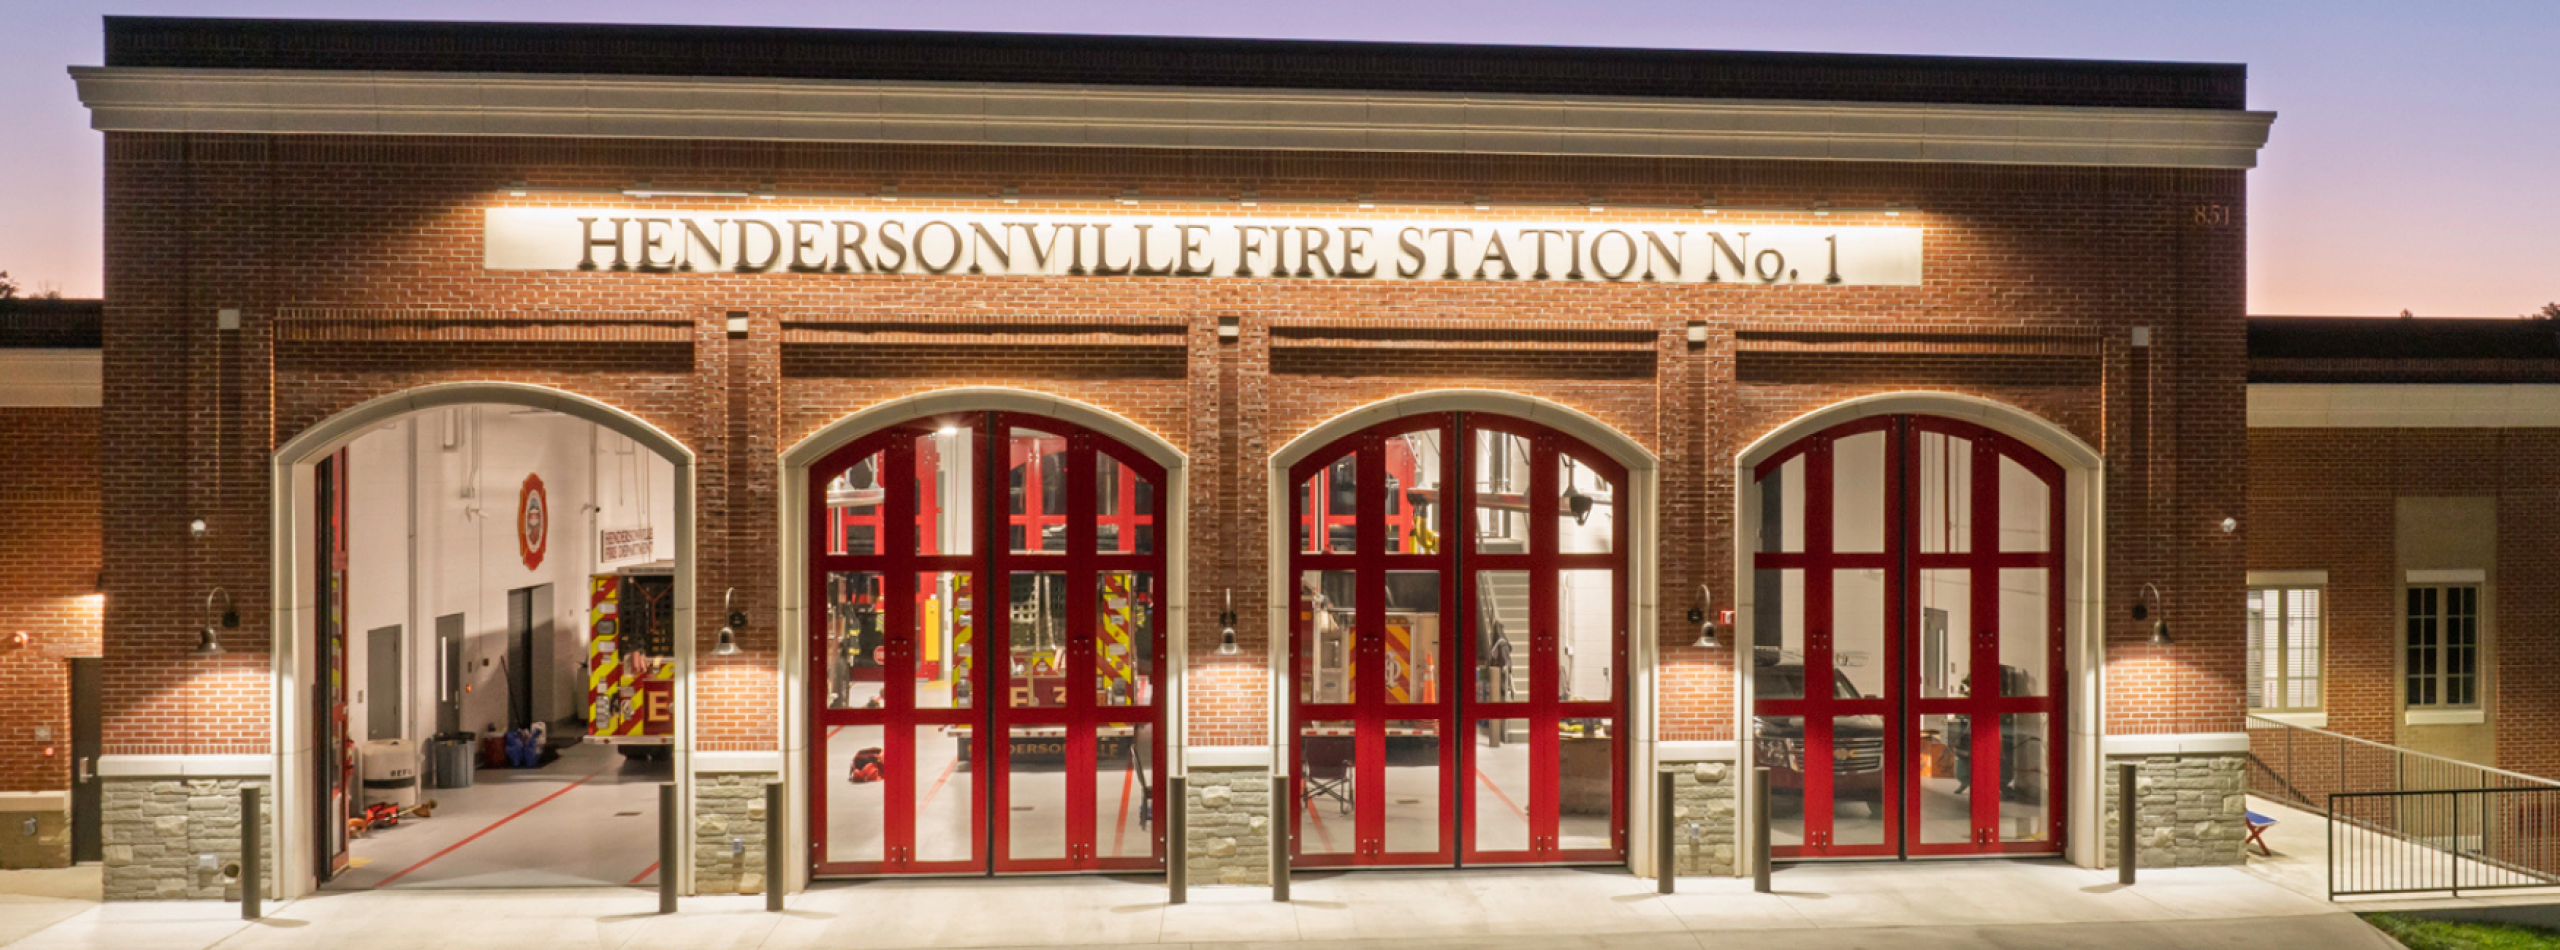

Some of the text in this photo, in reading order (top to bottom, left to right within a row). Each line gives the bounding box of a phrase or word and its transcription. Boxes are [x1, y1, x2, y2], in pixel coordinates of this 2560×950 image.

[2195, 205, 2230, 226] 851
[577, 217, 1844, 284] HENDERSONVILLE FIRE STATION No. 1
[648, 691, 670, 721] E
